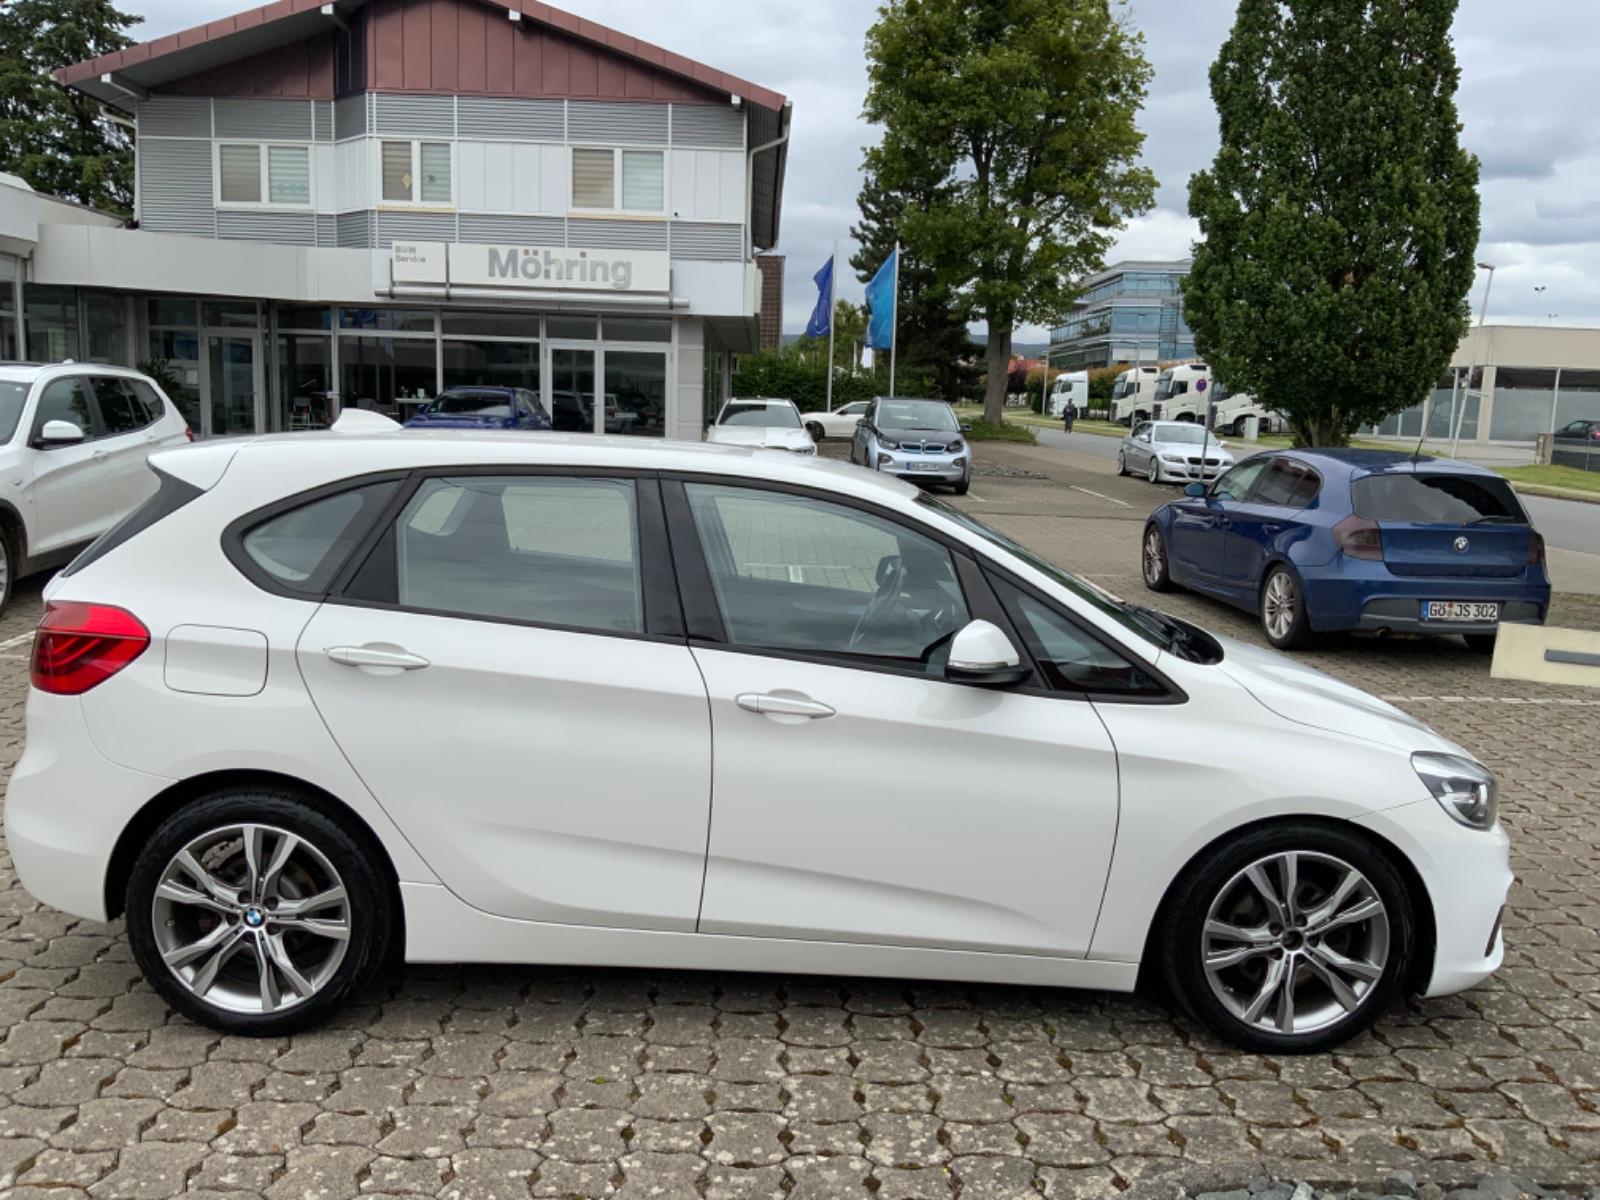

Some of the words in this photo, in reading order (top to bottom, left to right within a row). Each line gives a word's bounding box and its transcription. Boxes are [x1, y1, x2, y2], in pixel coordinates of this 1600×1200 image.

[394, 254, 427, 263] Service
[488, 247, 632, 289] Möhring
[1454, 604, 1471, 617] JS
[1473, 605, 1496, 618] 302
